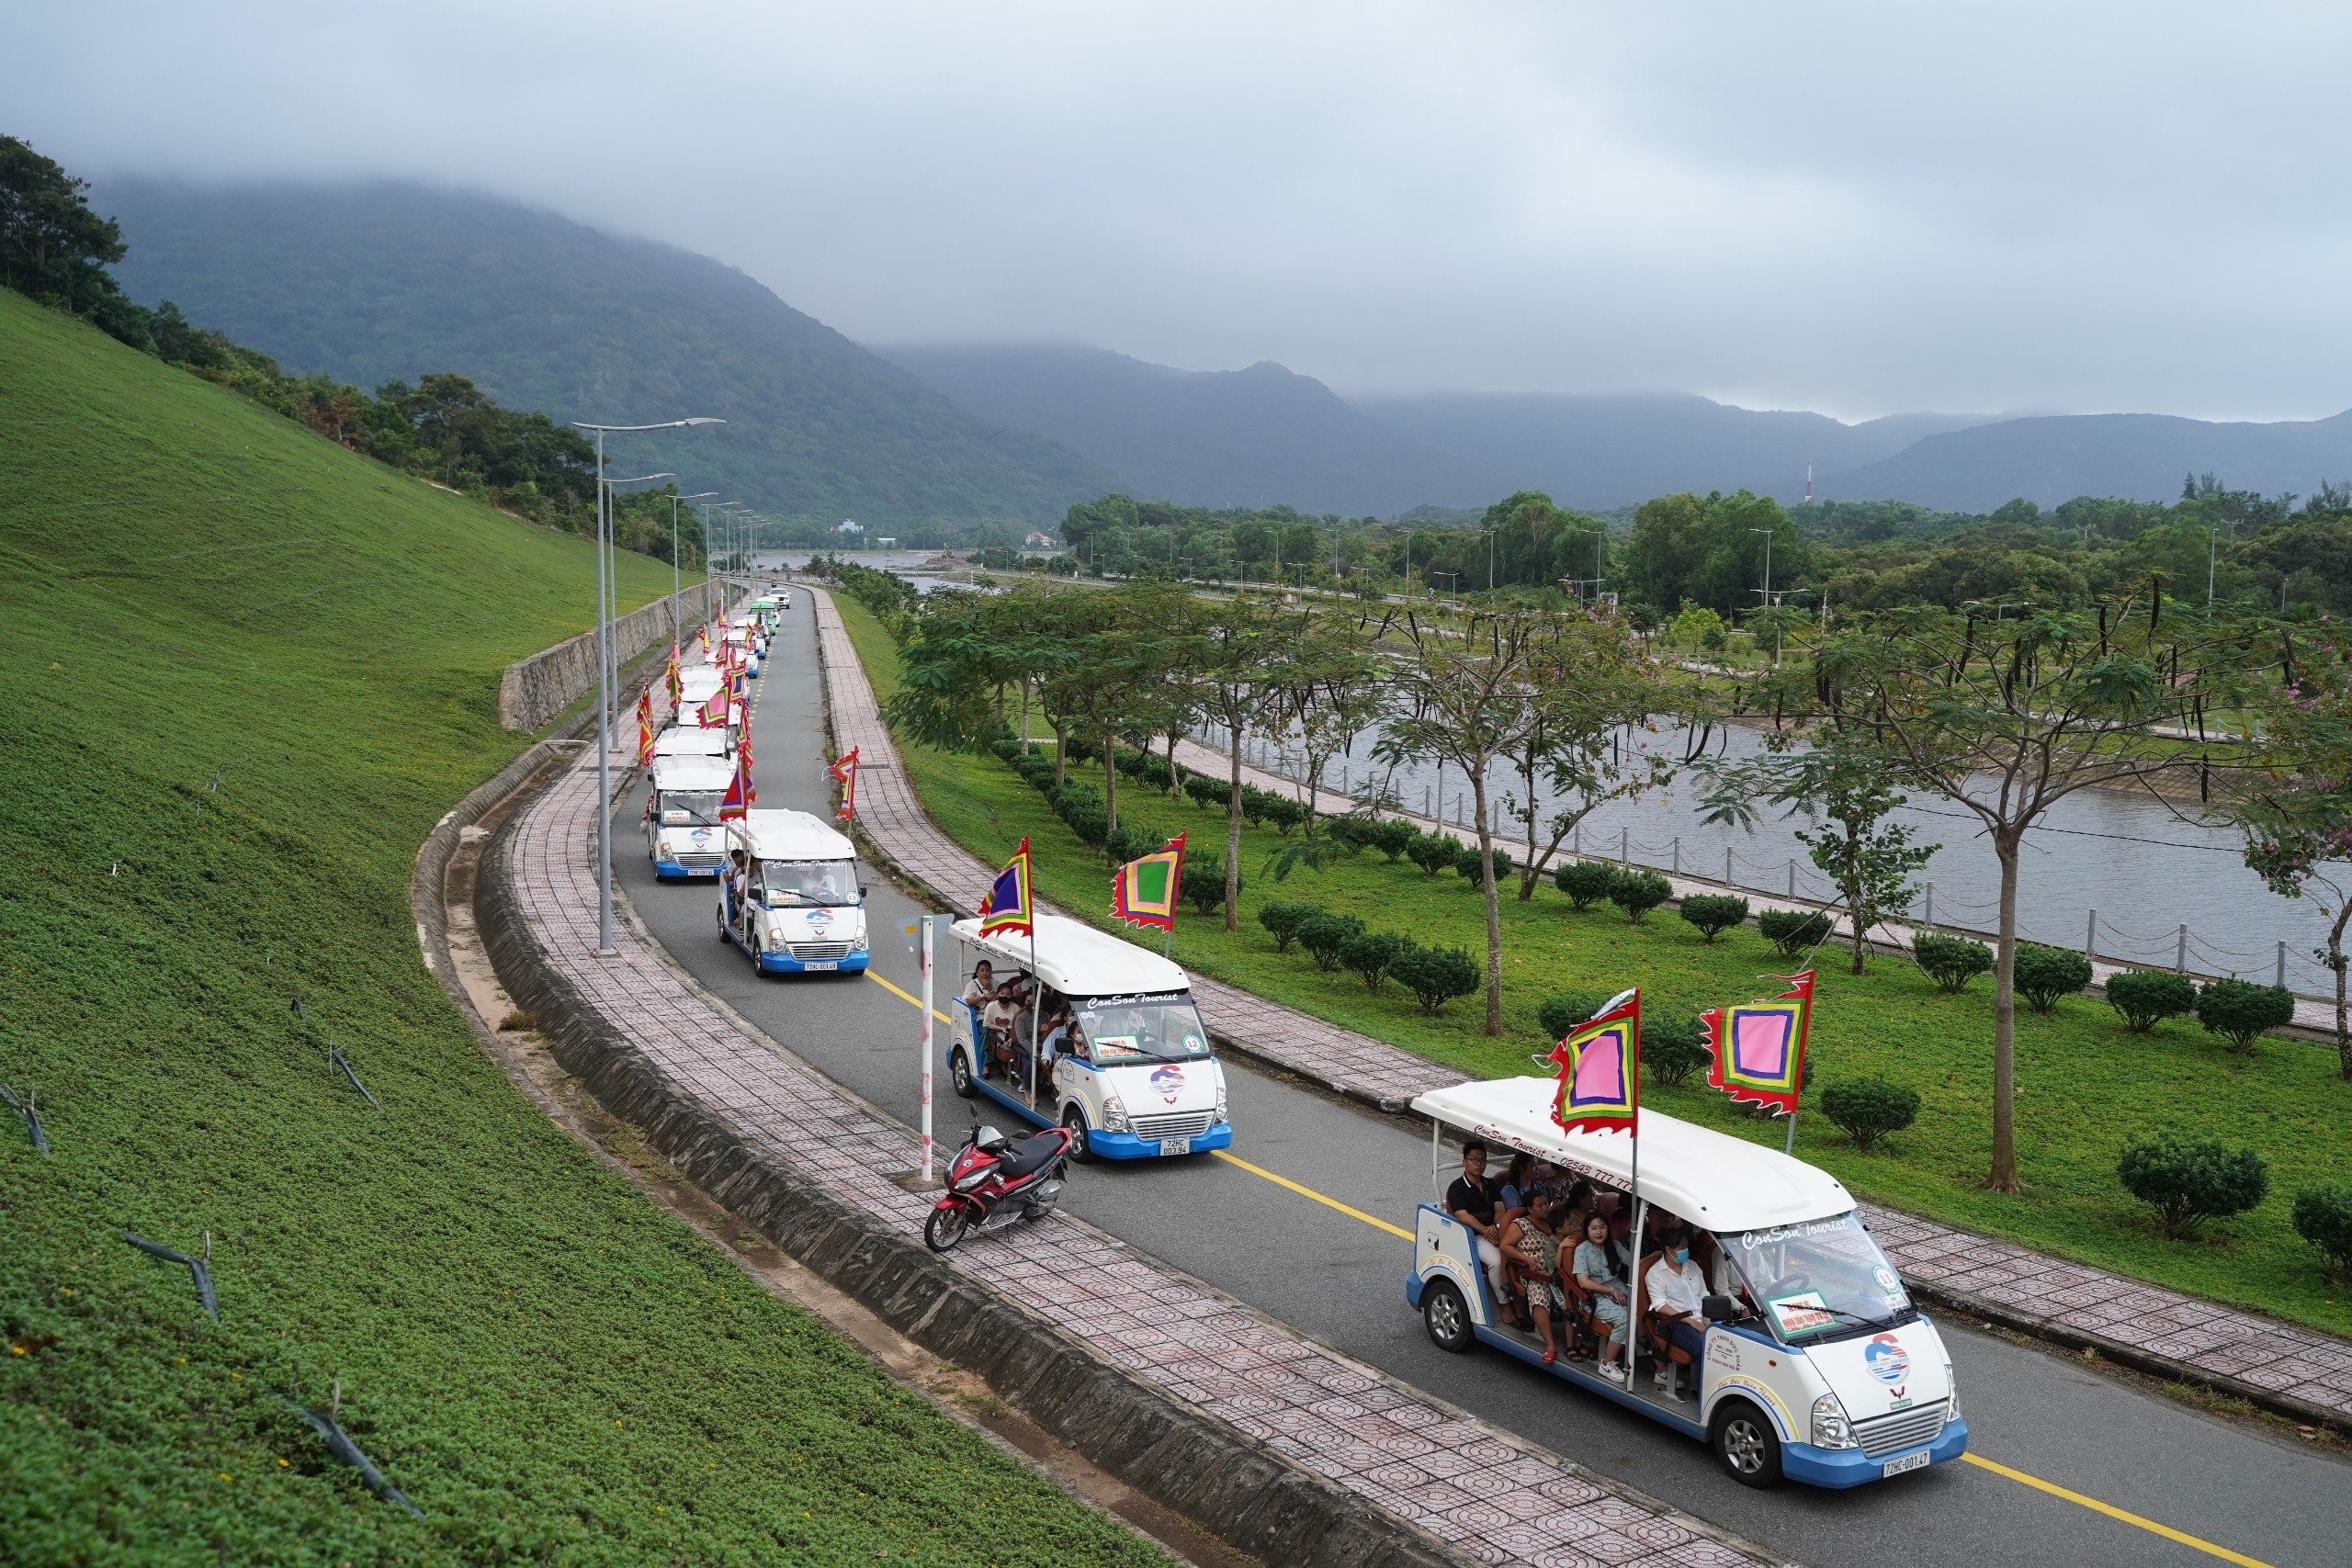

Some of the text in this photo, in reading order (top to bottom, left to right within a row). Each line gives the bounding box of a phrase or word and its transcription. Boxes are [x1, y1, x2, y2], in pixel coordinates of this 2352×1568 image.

[773, 860, 811, 869] ConSon
[1086, 993, 1179, 1010] ConSon Tourist
[1188, 1040, 1198, 1048] 12
[1167, 1139, 1184, 1147] 72HC
[1474, 1123, 1508, 1143] ConSon
[1511, 1136, 1546, 1157] Tourist
[1560, 1157, 1592, 1174] 02543
[1595, 1169, 1614, 1182] 777
[1742, 1218, 1849, 1250] ConSon Tourist
[1880, 1273, 1894, 1284] 11
[1885, 1452, 1928, 1476] 72HC-001.47
